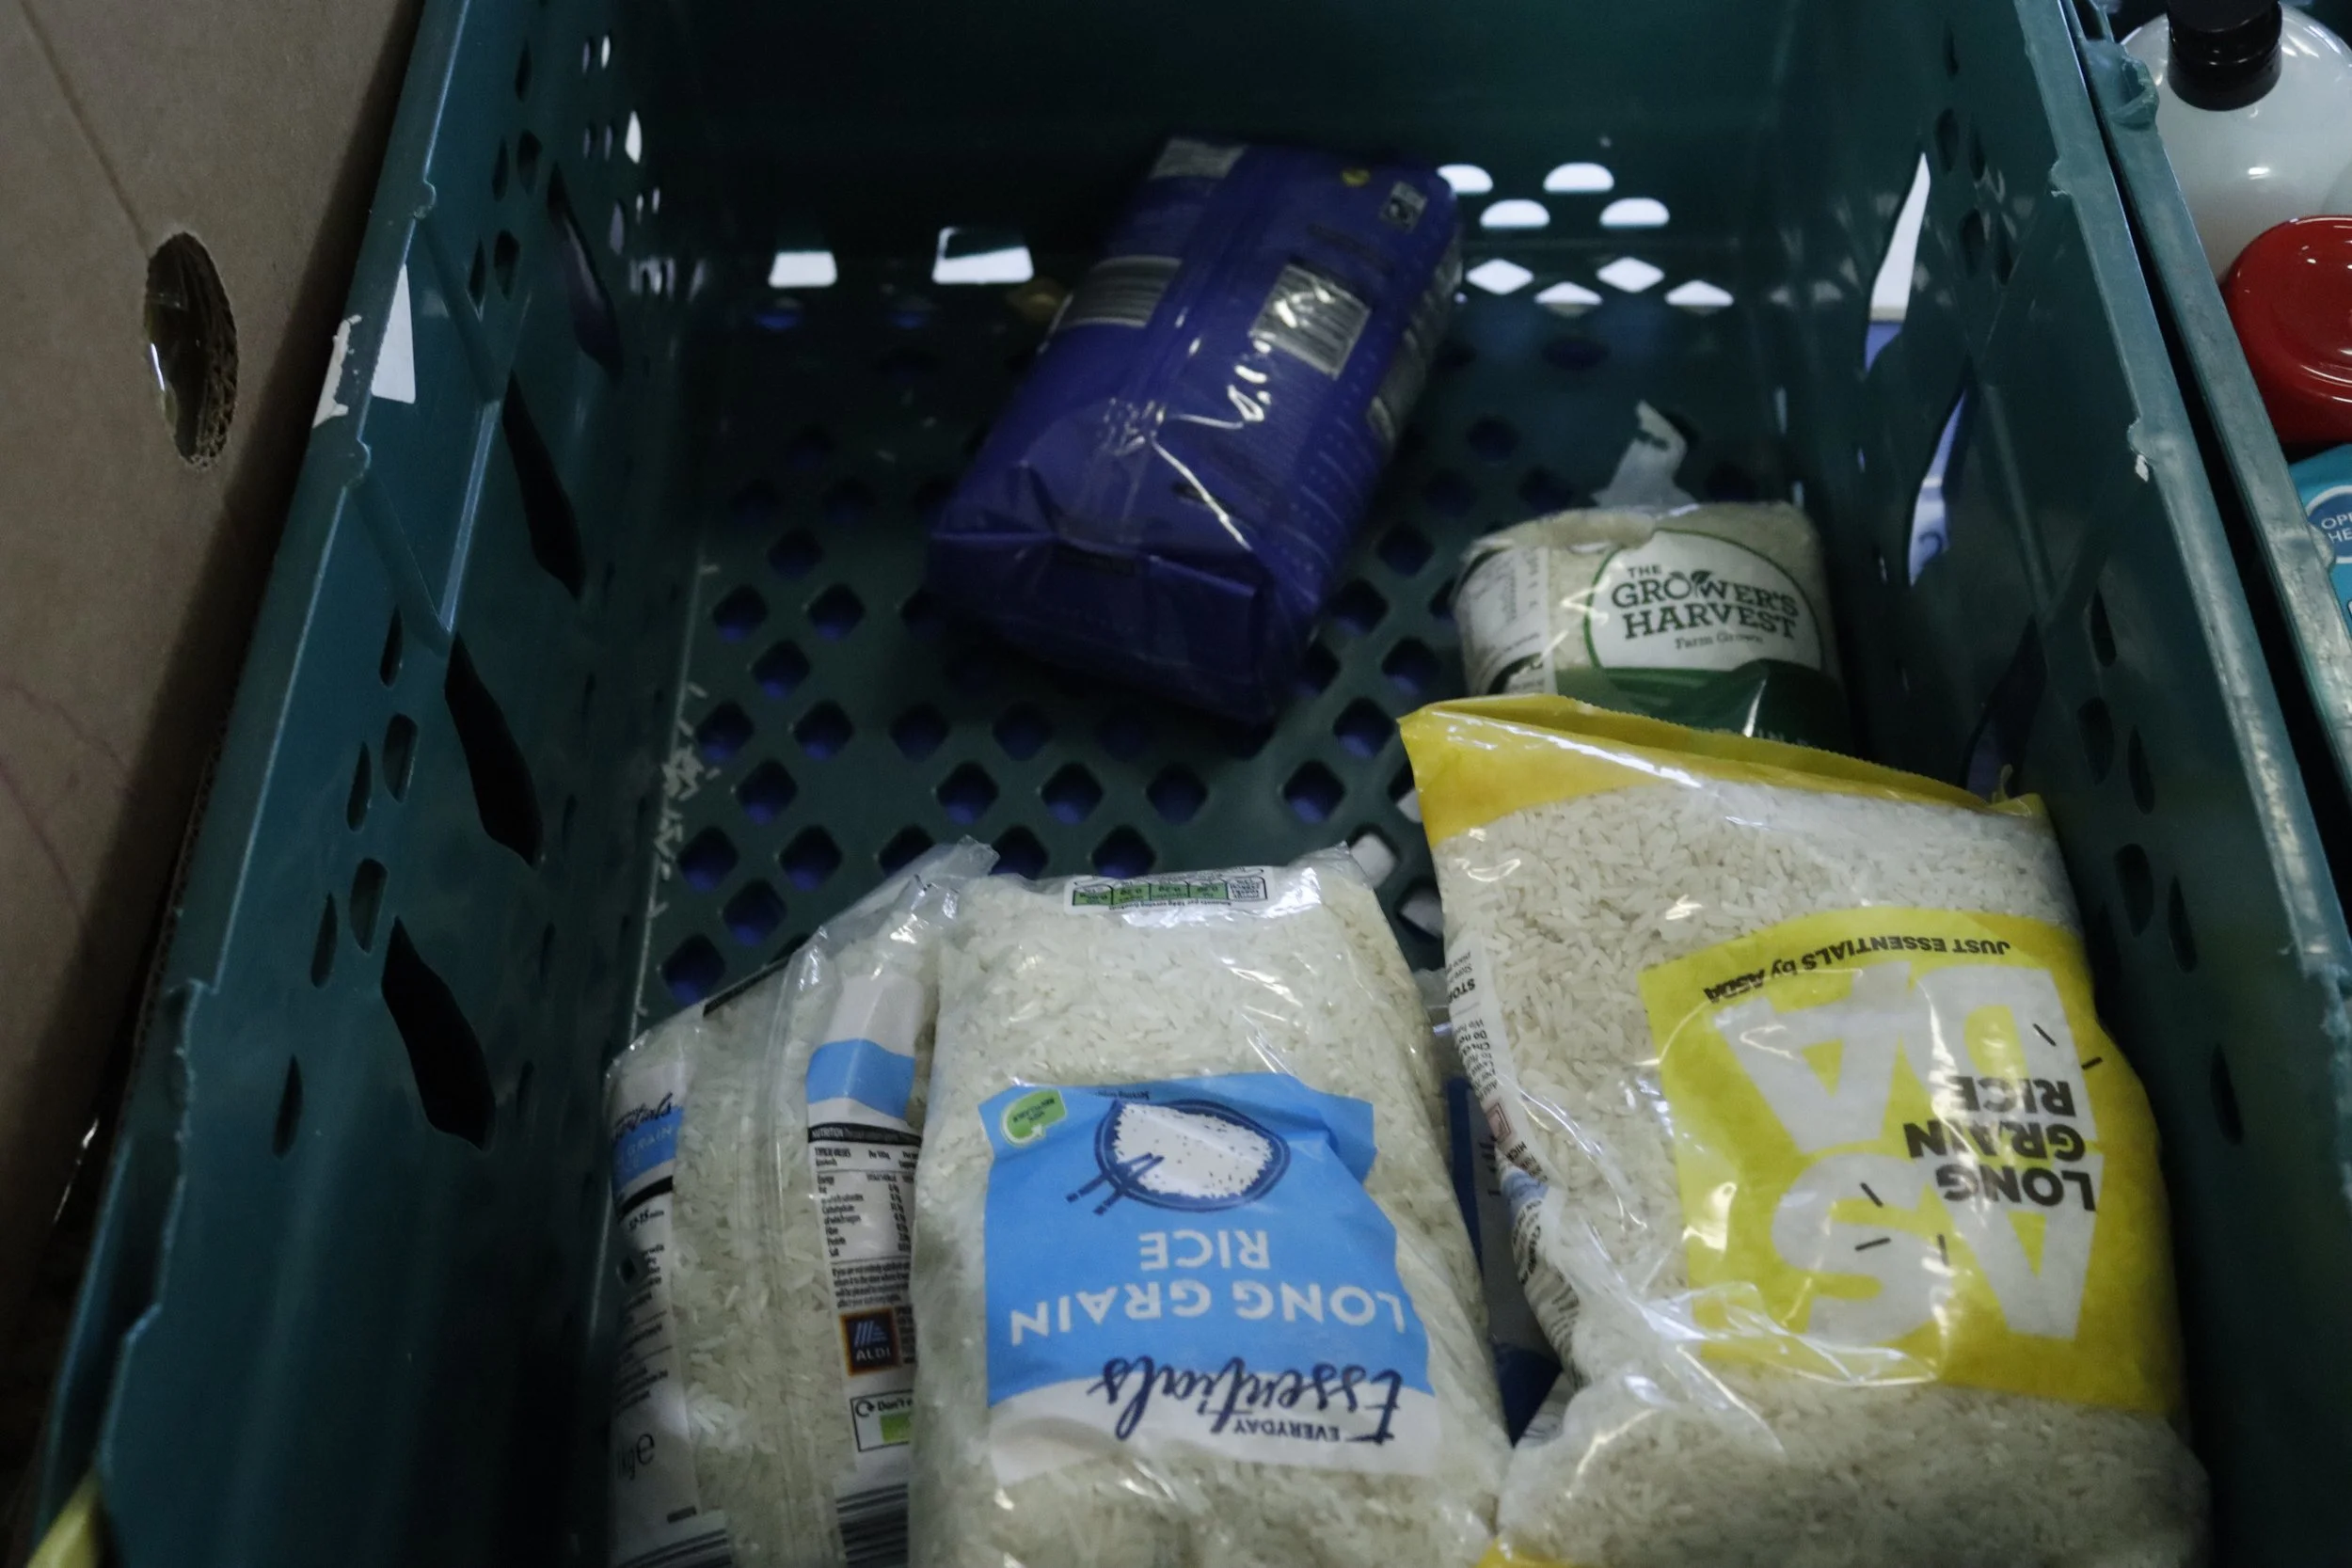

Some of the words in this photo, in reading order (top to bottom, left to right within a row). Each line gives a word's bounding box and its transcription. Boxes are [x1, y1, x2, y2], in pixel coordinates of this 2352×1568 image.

[1627, 563, 1662, 578] THE
[1612, 570, 1800, 616] GROWER'S
[1623, 602, 1797, 641] HARVEST
[1675, 632, 1714, 651] Farm
[1717, 632, 1764, 646] Grown
[1800, 934, 1948, 974] ESSENTIALS
[1952, 935, 2010, 958] JUST
[1770, 958, 1798, 979] by
[1946, 1075, 2075, 1117] RICE
[1903, 1119, 2086, 1162] GRAIN
[1936, 1163, 2097, 1212] LONG
[1139, 1230, 1270, 1271] RICE
[1009, 1281, 1212, 1347] GRAIN
[1232, 1282, 1406, 1334] LONG
[856, 1349, 891, 1362] ALDI
[877, 1397, 905, 1411] Don't
[1087, 1353, 1403, 1446] Essentials
[1232, 1418, 1340, 1444] EVERYDAY
